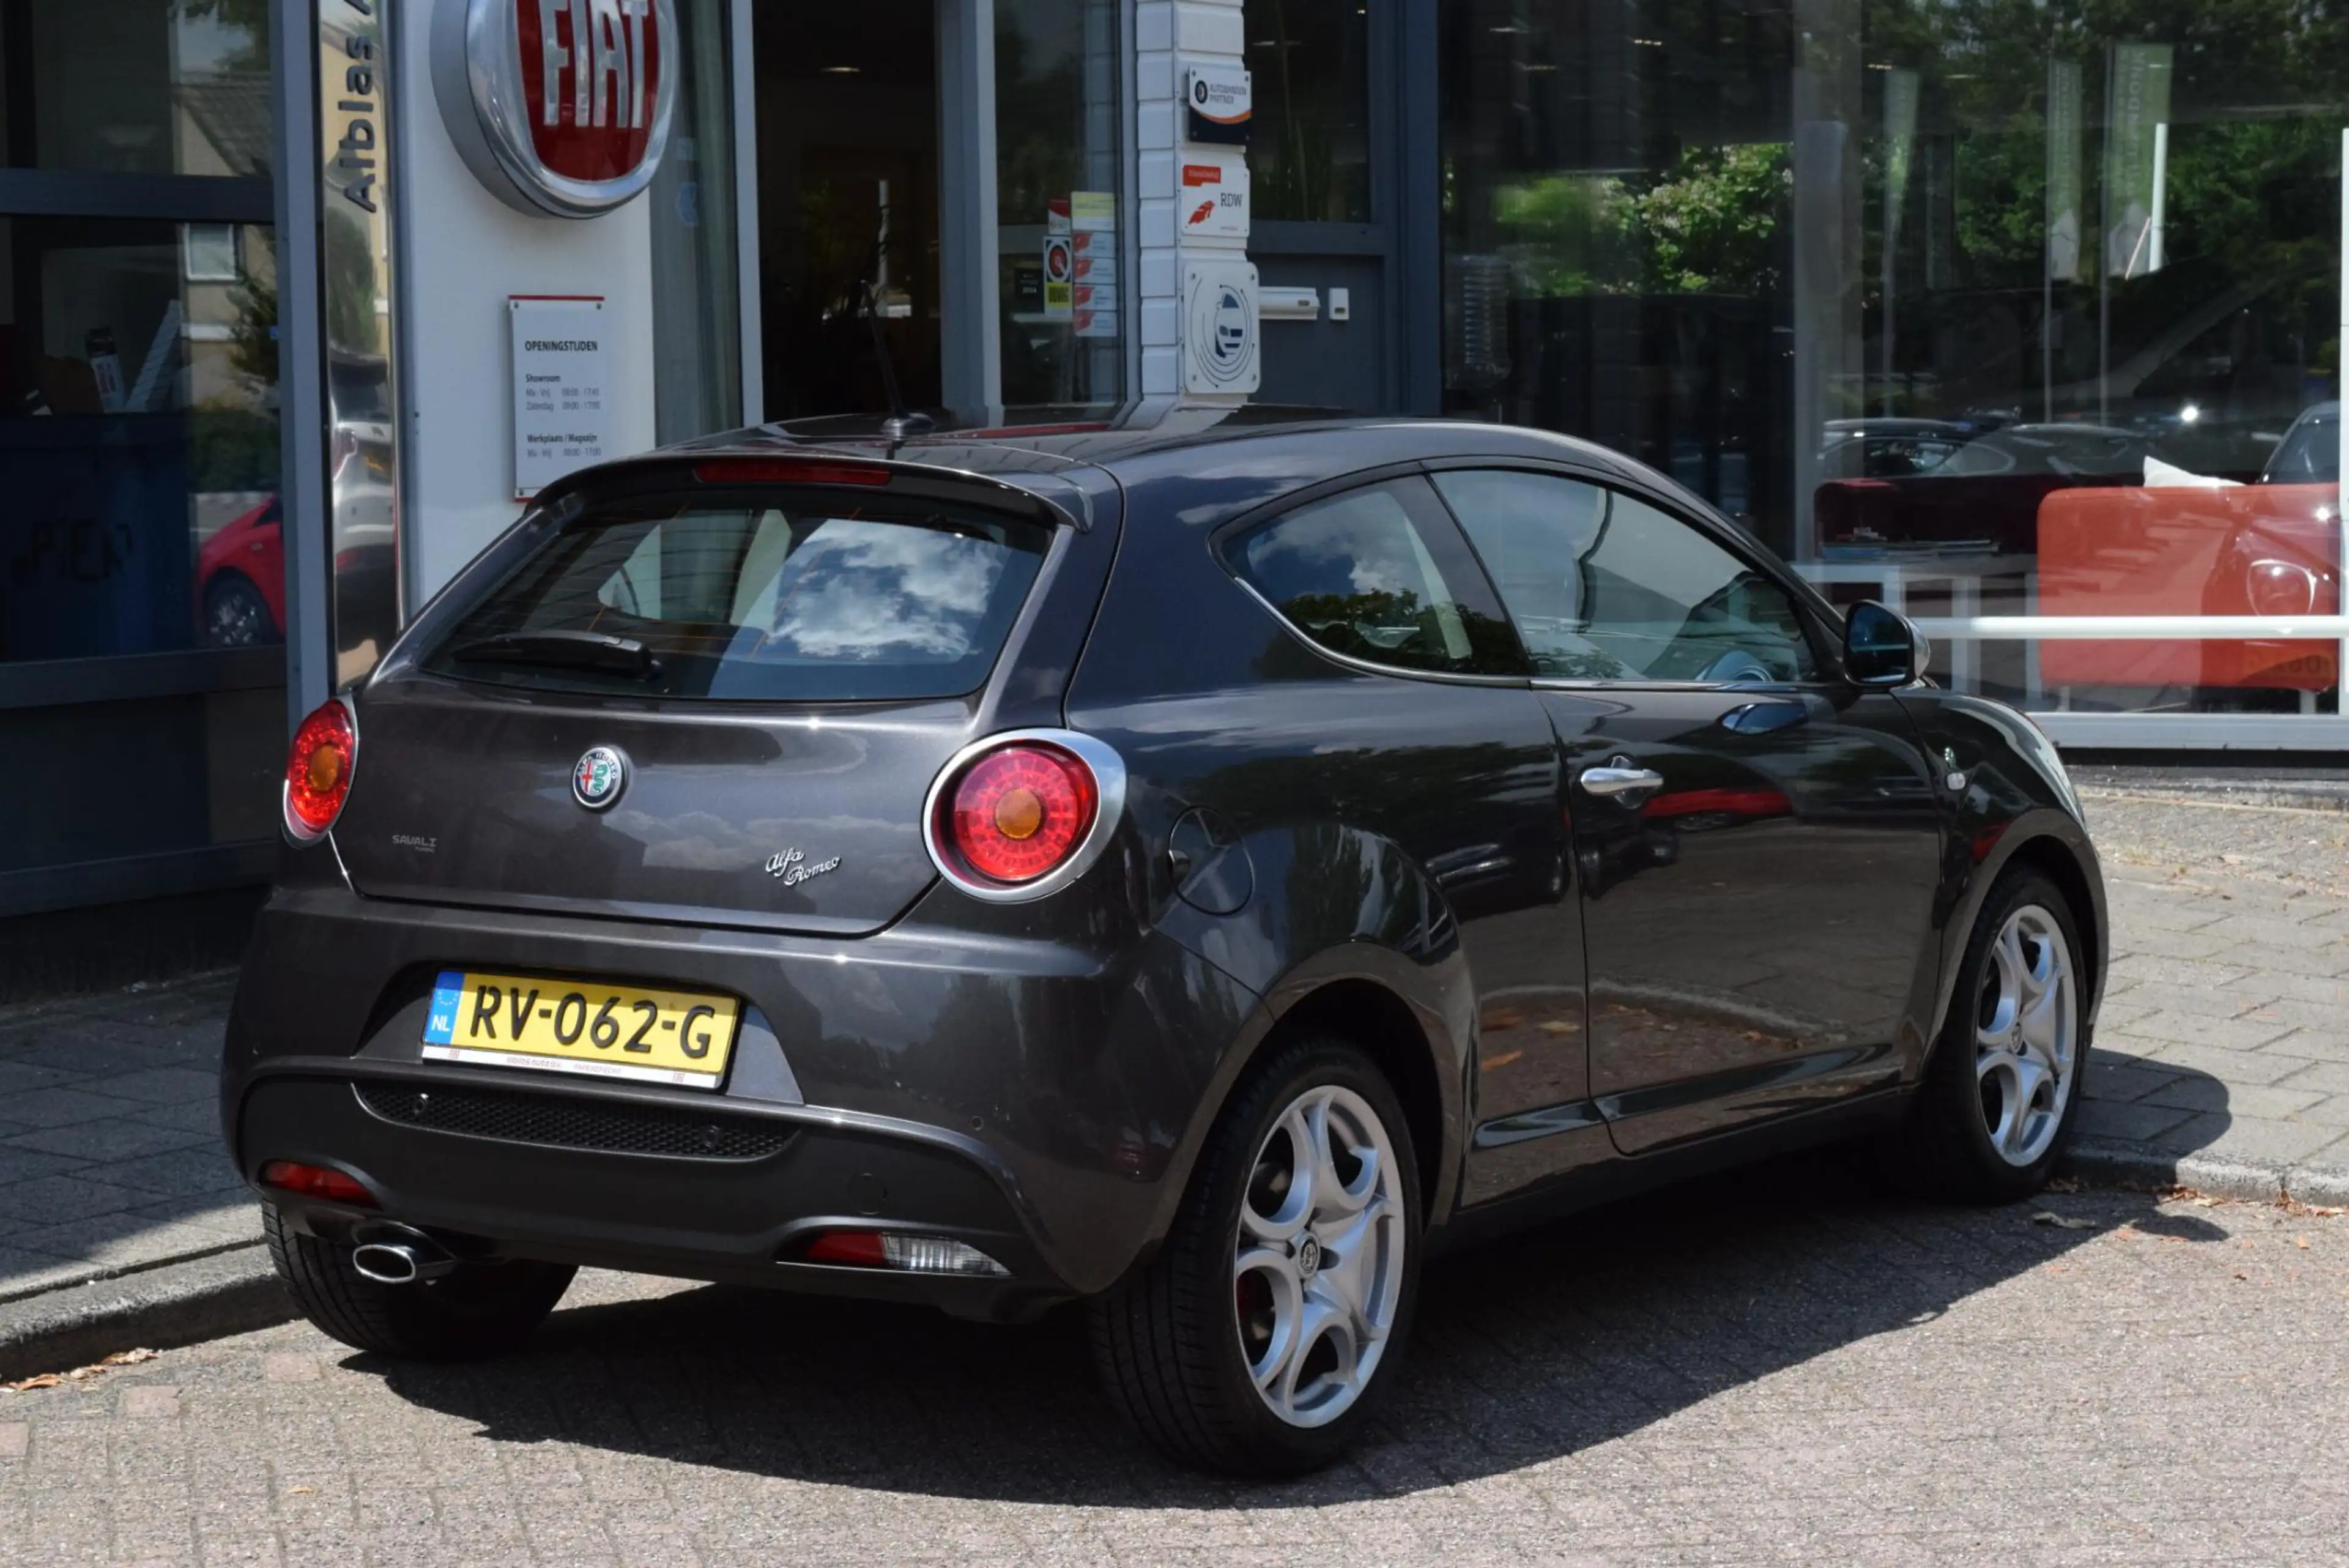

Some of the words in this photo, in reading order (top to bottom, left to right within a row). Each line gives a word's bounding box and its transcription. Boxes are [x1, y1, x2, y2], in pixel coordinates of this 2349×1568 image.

[539, 0, 648, 128] FIAT
[338, 35, 377, 213] Alblas
[1220, 193, 1243, 207] RDW
[765, 847, 804, 877] Alfa
[784, 855, 841, 886] Romeo
[431, 1016, 451, 1032] NL
[470, 984, 715, 1059] RV-062-G
